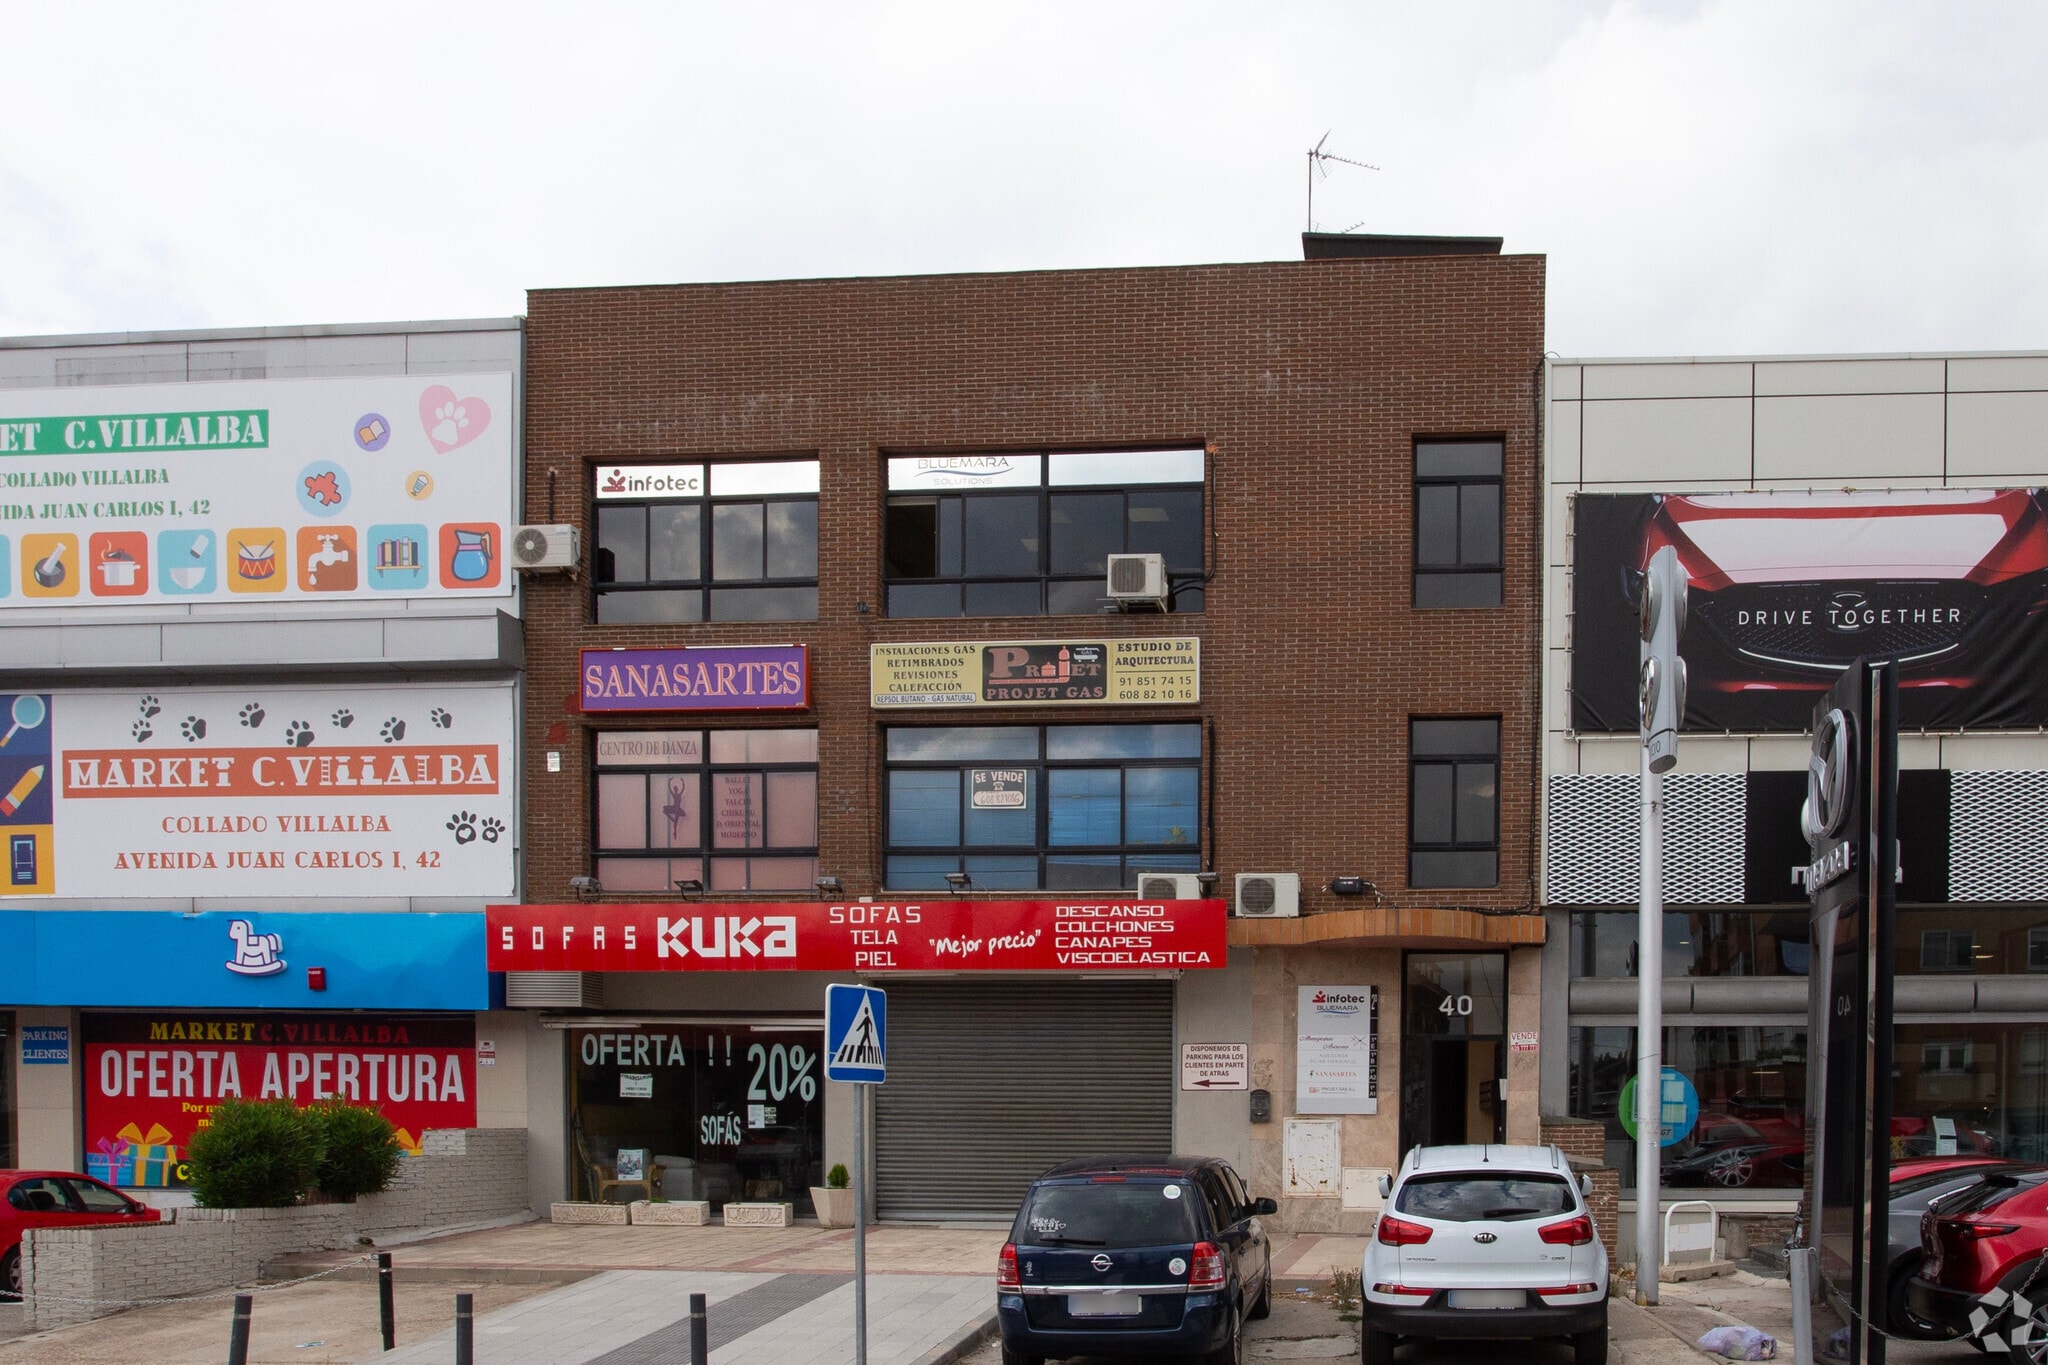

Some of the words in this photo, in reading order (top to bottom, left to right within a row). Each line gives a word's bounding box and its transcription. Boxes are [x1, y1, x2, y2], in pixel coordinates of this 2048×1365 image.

[64, 414, 265, 449] C.VILLALBA
[918, 457, 1009, 469] BLUEMARA
[0, 471, 77, 488] COLLADO
[82, 468, 170, 486] VILLALBA
[629, 474, 699, 492] infotec
[933, 477, 993, 485] SOLUTIONS
[0, 503, 35, 520] IDA
[40, 502, 88, 519] JUAN
[93, 500, 165, 518] CARLOS
[188, 499, 211, 516] 42
[1738, 610, 1812, 625] DRIVE
[1829, 608, 1961, 625] TOGETHER
[875, 646, 950, 656] INSTALACIONES
[953, 645, 976, 654] GAS
[1118, 642, 1172, 652] ESTUDIO
[1176, 641, 1192, 651] DE
[887, 658, 964, 668] RETIMBRADOS
[1115, 655, 1194, 667] ARQUITECTURA
[585, 661, 801, 698] SANASARTES
[893, 670, 958, 680] REVISIONES
[1119, 676, 1132, 686] 91
[1136, 676, 1156, 686] 851
[1161, 676, 1175, 685] 74
[1178, 675, 1192, 685] 15
[889, 680, 963, 692] CALEFACCIÓN
[876, 695, 900, 703] REPSOL
[931, 694, 944, 702] GAS
[946, 694, 973, 702] NATURAL
[986, 686, 1058, 700] PROJET
[1066, 686, 1103, 698] GAS
[1119, 690, 1140, 699] 608
[1143, 690, 1157, 699] 82
[1161, 689, 1175, 699] 10
[1178, 689, 1192, 698] 16
[600, 741, 643, 756] CENTRO
[646, 741, 661, 755] DE
[662, 740, 698, 755] DANZA
[68, 757, 235, 788] MARKET
[252, 754, 496, 788] C.VILLALBA
[974, 772, 987, 783] SE
[991, 771, 1024, 783] VENDE
[162, 815, 268, 834] COLLADO
[277, 814, 392, 833] VILLALBA
[114, 852, 218, 870] AVENIDA
[226, 851, 285, 869] JUAN
[294, 851, 384, 869] CARLOS
[415, 850, 441, 868] 42
[830, 906, 921, 925] SOFAS
[1055, 905, 1164, 917] DESCANSO
[1055, 920, 1175, 933] COLCHONES
[502, 925, 636, 950] SOFAS
[850, 930, 898, 945] TELA
[1055, 936, 1152, 948] CANAPES
[855, 950, 897, 966] PIEL
[1057, 951, 1211, 964] VISCOELASTICA
[1326, 994, 1365, 1003] infotec
[1439, 995, 1473, 1016] 40
[22, 1031, 67, 1041] PARKING
[150, 1022, 256, 1041] MARKET
[260, 1022, 410, 1044] C.VILLALBA
[1511, 1032, 1537, 1040] VENDE
[22, 1048, 69, 1059] CLIENTES
[582, 1034, 686, 1067] OFERTA
[100, 1049, 242, 1100] OFERTA
[261, 1052, 466, 1103] APERTURA
[747, 1043, 817, 1102] 20%
[181, 1102, 204, 1113] Por
[701, 1111, 742, 1146] SOFÁS
[1477, 1233, 1494, 1242] KIA
